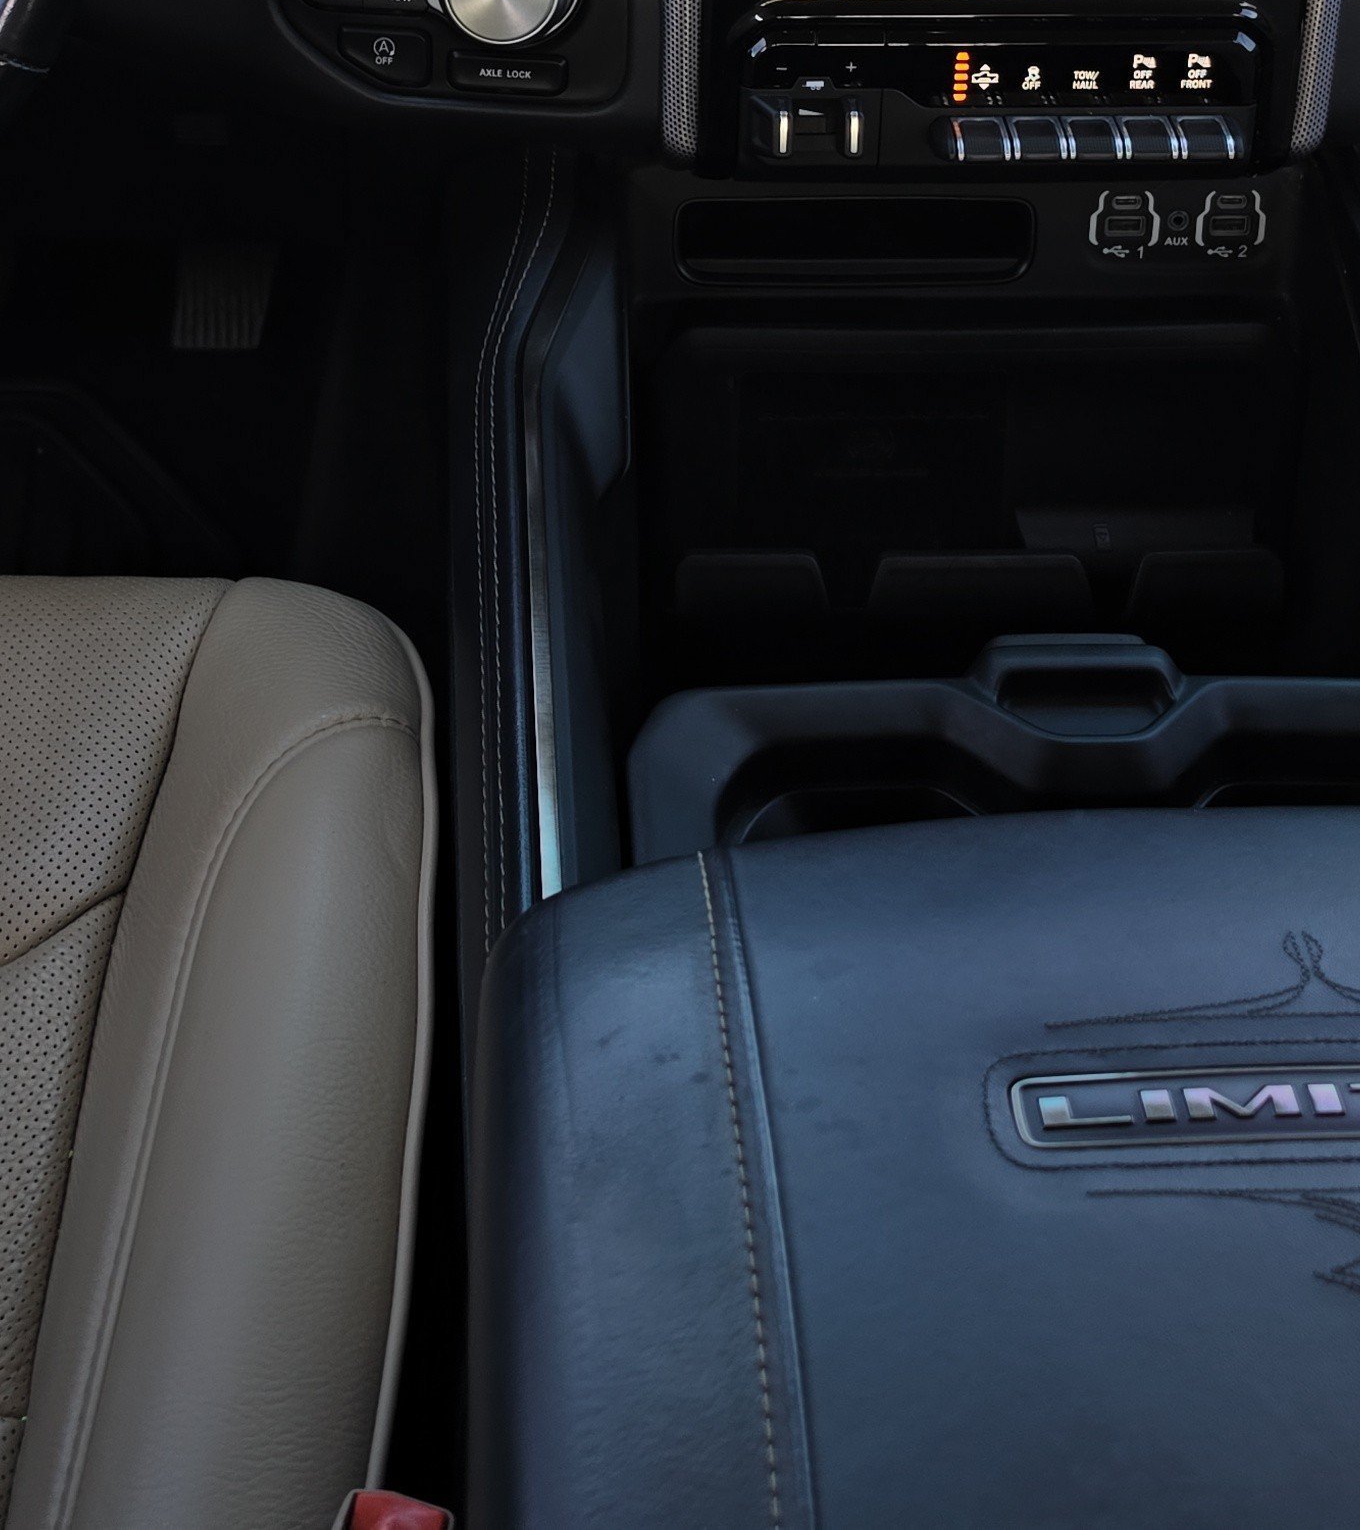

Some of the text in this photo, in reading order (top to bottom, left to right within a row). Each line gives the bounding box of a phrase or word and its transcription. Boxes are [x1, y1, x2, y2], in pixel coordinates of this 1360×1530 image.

[375, 55, 394, 66] OFF
[479, 67, 531, 80] AXLE LOCK
[1073, 70, 1099, 81] TOW/
[1133, 70, 1153, 79] OFF
[1187, 69, 1207, 79] OFF
[1021, 81, 1041, 90] OFF
[1072, 80, 1099, 90] HAUL
[1129, 80, 1155, 90] REAR
[1180, 79, 1213, 89] FRONT
[1164, 236, 1189, 246] AUX
[1137, 246, 1144, 259] 1
[1237, 245, 1248, 258] 2
